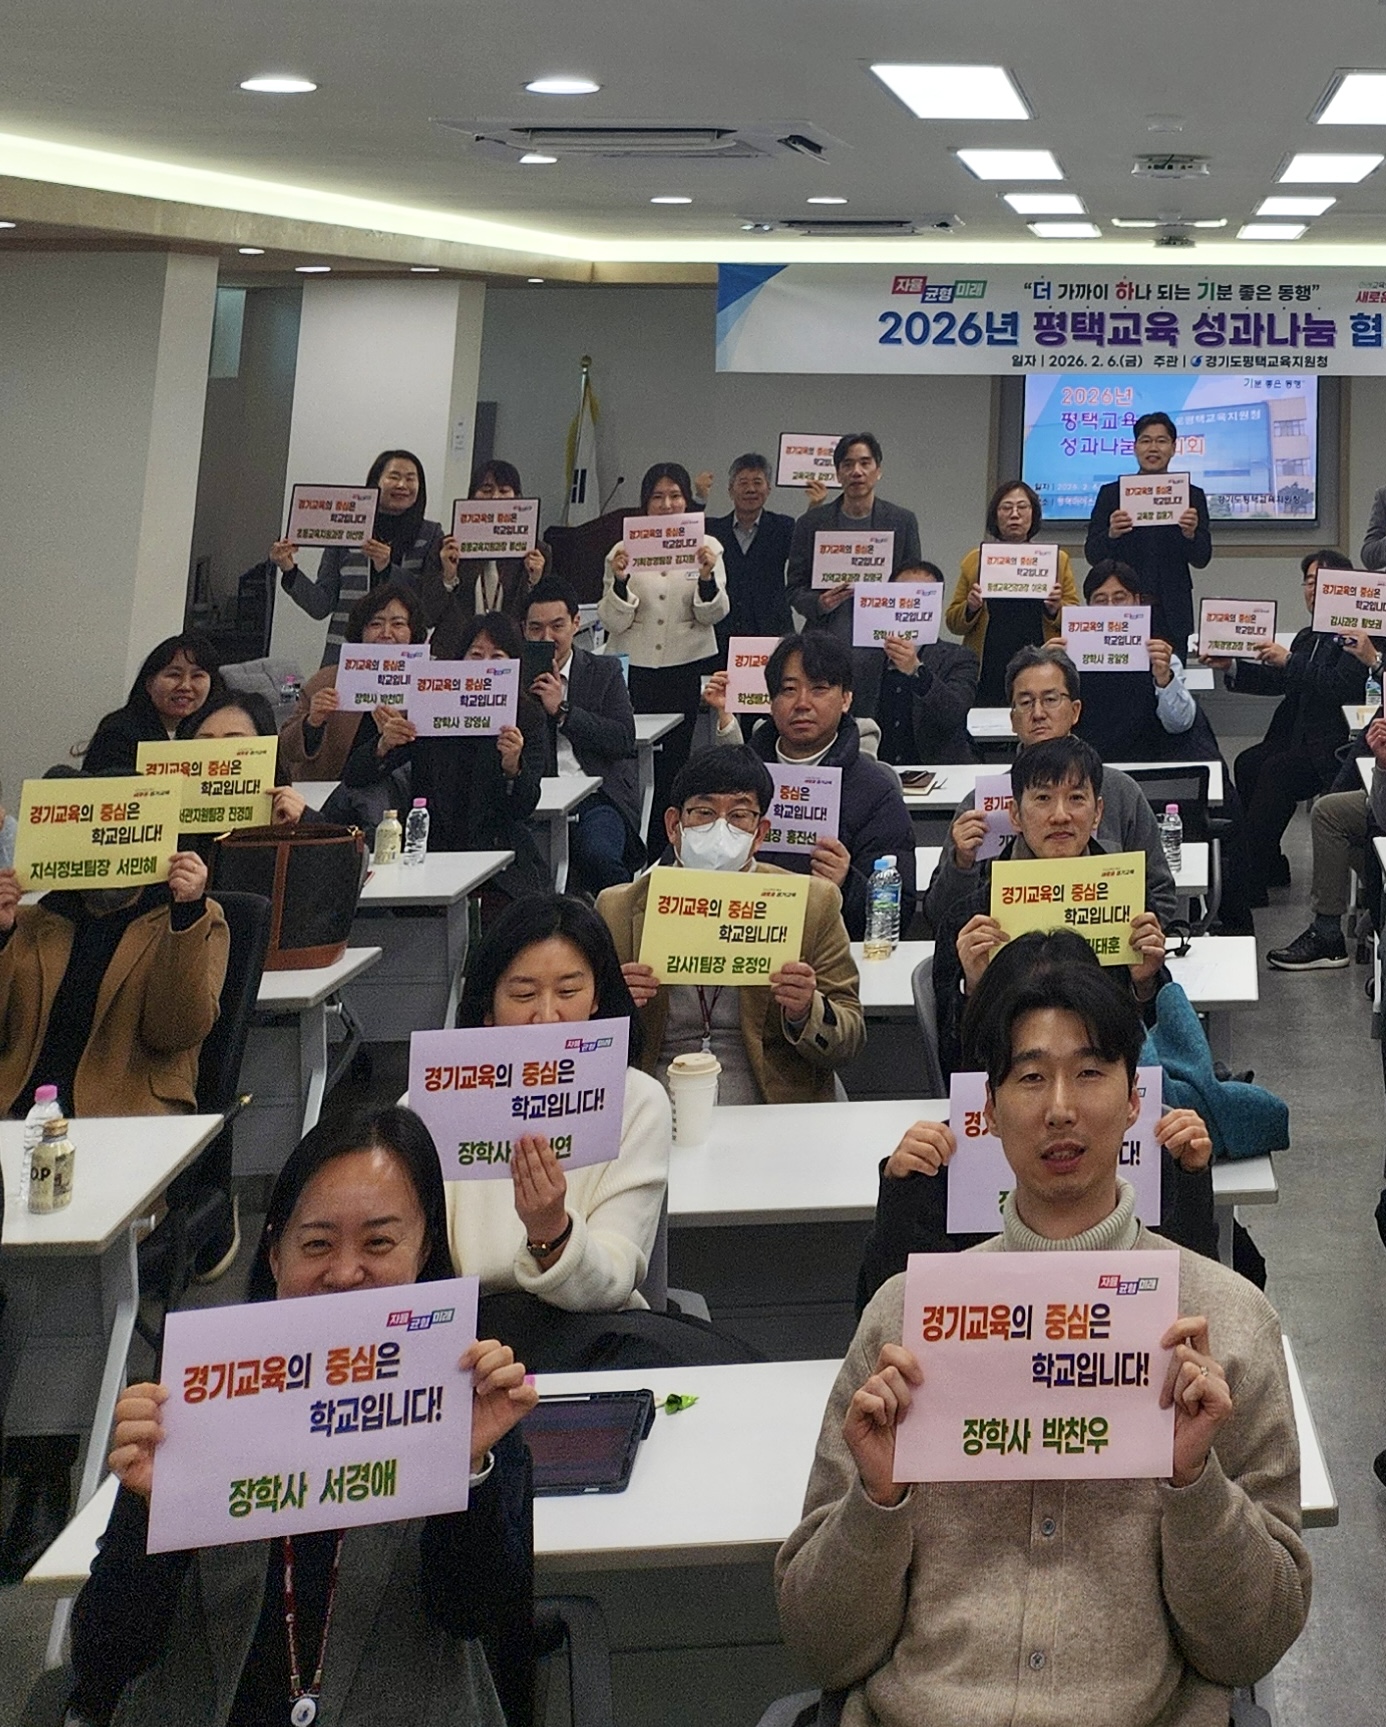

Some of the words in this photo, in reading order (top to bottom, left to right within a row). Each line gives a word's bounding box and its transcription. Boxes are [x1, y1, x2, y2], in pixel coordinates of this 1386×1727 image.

[896, 279, 924, 292] 자율
[924, 288, 954, 302] 균형
[955, 282, 984, 296] 미래
[1058, 284, 1108, 300] 가까이
[1116, 282, 1152, 300] 하나
[1157, 284, 1190, 300] 되는
[1198, 282, 1232, 300] 기분
[1239, 285, 1272, 301] 좋은
[1278, 285, 1319, 301] 동행”
[879, 311, 1019, 346] 2026년
[1034, 311, 1179, 347] 평택교육
[1192, 312, 1336, 347] 성과나눔
[1012, 355, 1036, 367] 일자
[1049, 355, 1087, 367] 2026.
[1092, 355, 1103, 367] 2.
[1108, 355, 1142, 367] 6.(금)
[1154, 356, 1178, 367] 주관
[1206, 356, 1327, 368] 경기도평택교육지원청
[1061, 387, 1133, 406] 2026년
[1323, 584, 1357, 596] 경기교육의
[1360, 586, 1380, 598] 중심은
[1069, 622, 1104, 632] 경기교육의
[1108, 622, 1128, 632] 중심은
[1104, 636, 1141, 646] 학교입니다!
[418, 679, 461, 691] 경기교육의
[465, 678, 492, 691] 중심은
[460, 694, 507, 707] 학교입니다!
[434, 717, 460, 729] 장학사
[208, 760, 241, 776] 중심은
[201, 780, 260, 796] 학교입니다!
[780, 785, 810, 801] 중심은
[30, 804, 94, 824] 경기교육의
[101, 802, 140, 821] 중심은
[774, 804, 827, 821] 학교입니다!
[92, 824, 162, 845] 학교입니다!
[787, 830, 818, 846] 홍진선
[30, 859, 111, 880] 지식정보팀장
[116, 856, 157, 876] 서민혜
[1003, 885, 1064, 904] 경기교육의
[1072, 882, 1108, 901] 중심은
[658, 896, 722, 918] 경기교육의
[729, 901, 767, 919] 중심은
[1064, 905, 1130, 926] 학교입니다!
[719, 925, 787, 943] 학교입니다!
[667, 956, 726, 973] 감사1팀장
[733, 957, 771, 974] 윤정인
[425, 1063, 512, 1091] 경기교육의
[522, 1059, 575, 1086] 중심은
[512, 1088, 605, 1120] 학교입니다!
[459, 1141, 511, 1166] 장학사
[1099, 1275, 1122, 1292] 자율
[1118, 1279, 1141, 1294] 균형
[1138, 1278, 1160, 1292] 미래
[387, 1310, 413, 1326] 자율
[408, 1314, 433, 1330] 균형
[431, 1308, 456, 1323] 미래
[923, 1305, 1033, 1342] 경기교육의
[1045, 1303, 1110, 1340] 중심은
[184, 1353, 312, 1404] 경기교육의
[326, 1342, 400, 1385] 중심은
[1032, 1352, 1149, 1388] 학교입니다!
[310, 1387, 444, 1437] 학교입니다!
[963, 1418, 1031, 1455] 장학사
[1043, 1417, 1108, 1454] 박찬우
[229, 1472, 307, 1517] 장학사
[319, 1459, 396, 1504] 서경애
